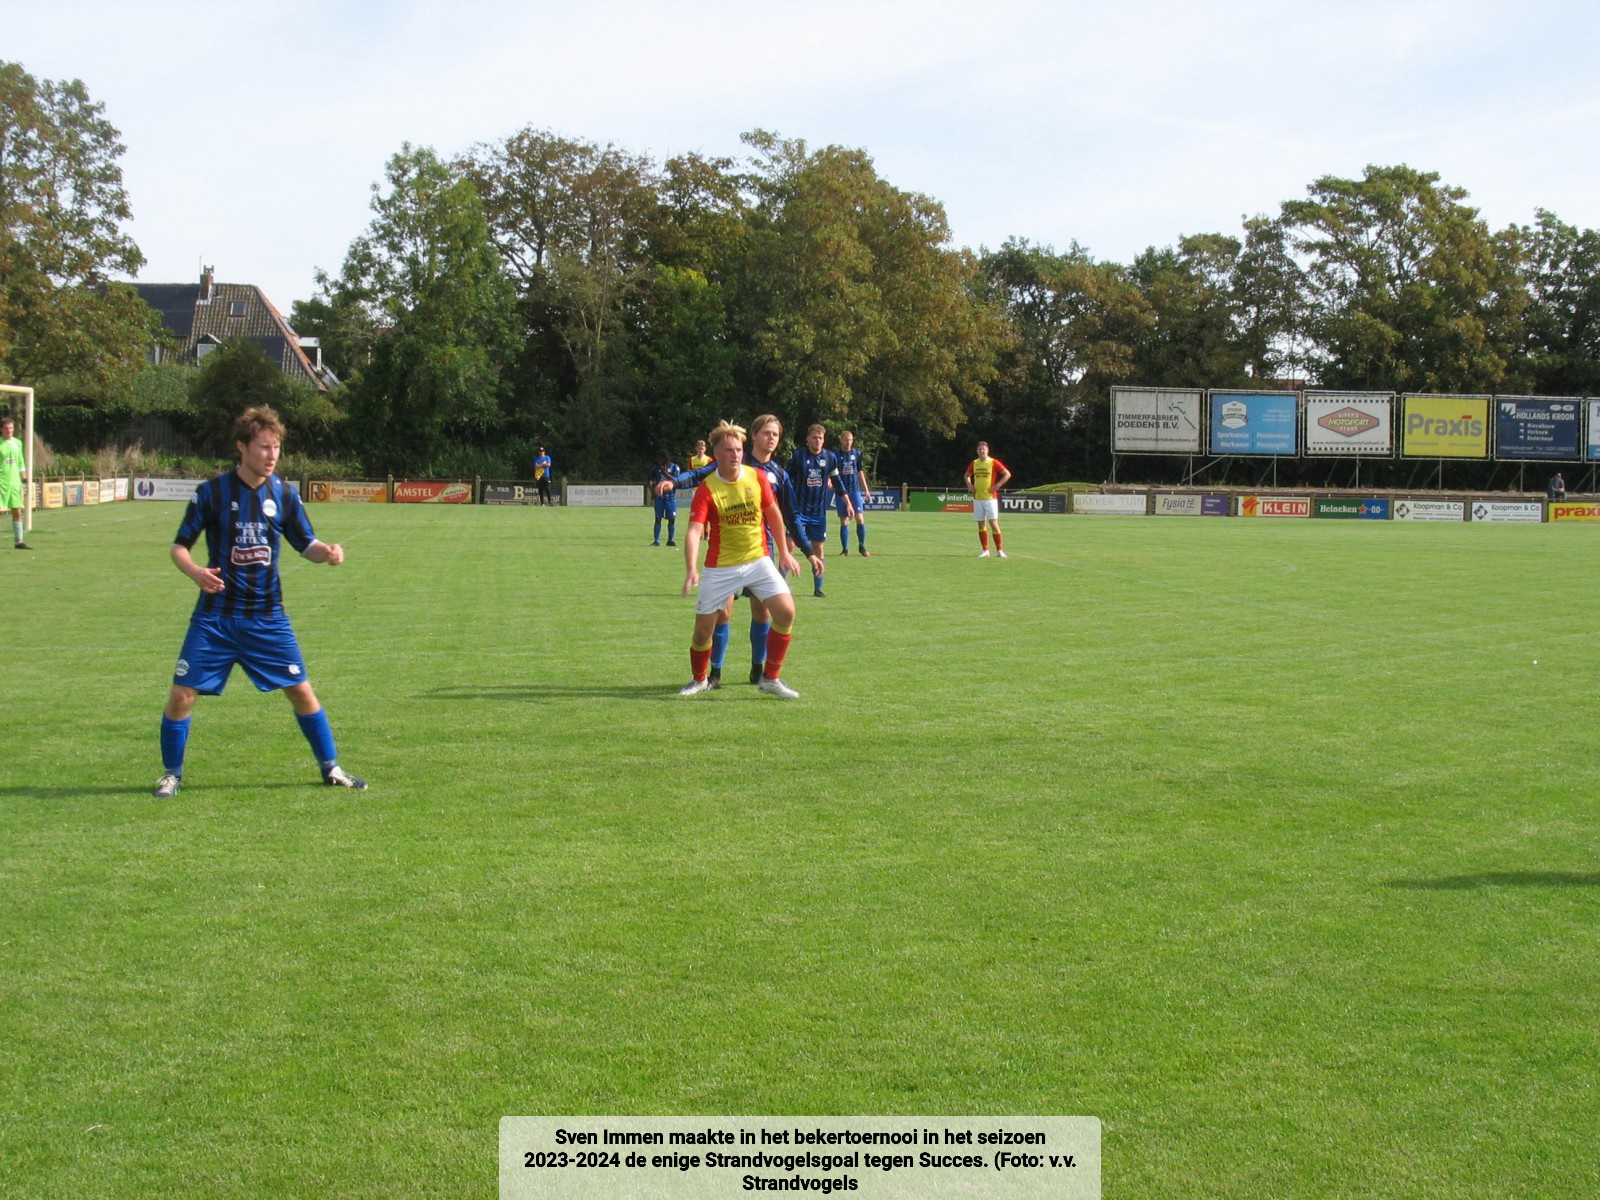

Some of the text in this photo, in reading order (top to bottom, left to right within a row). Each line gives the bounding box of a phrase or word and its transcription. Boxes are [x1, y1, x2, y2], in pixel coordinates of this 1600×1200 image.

[1516, 412, 1575, 421] HOLLANDS KROON
[1117, 421, 1180, 430] DOEDENS B.V.
[1328, 418, 1370, 426] MOTOPORT
[1407, 413, 1483, 437] Praxis
[1216, 431, 1250, 439] Sportswear
[331, 486, 345, 495] Ron
[396, 487, 434, 497] AMSTEL
[877, 496, 895, 504] B.V.
[1001, 499, 1044, 510] TUTTO
[1162, 497, 1186, 511] Fysio
[1263, 502, 1307, 514] KLEIN
[1320, 504, 1358, 513] Heineken
[1413, 502, 1463, 511] Koopman & Co
[1491, 503, 1523, 512] Koopman
[1530, 504, 1540, 512] Co
[235, 536, 269, 544] OTTENS
